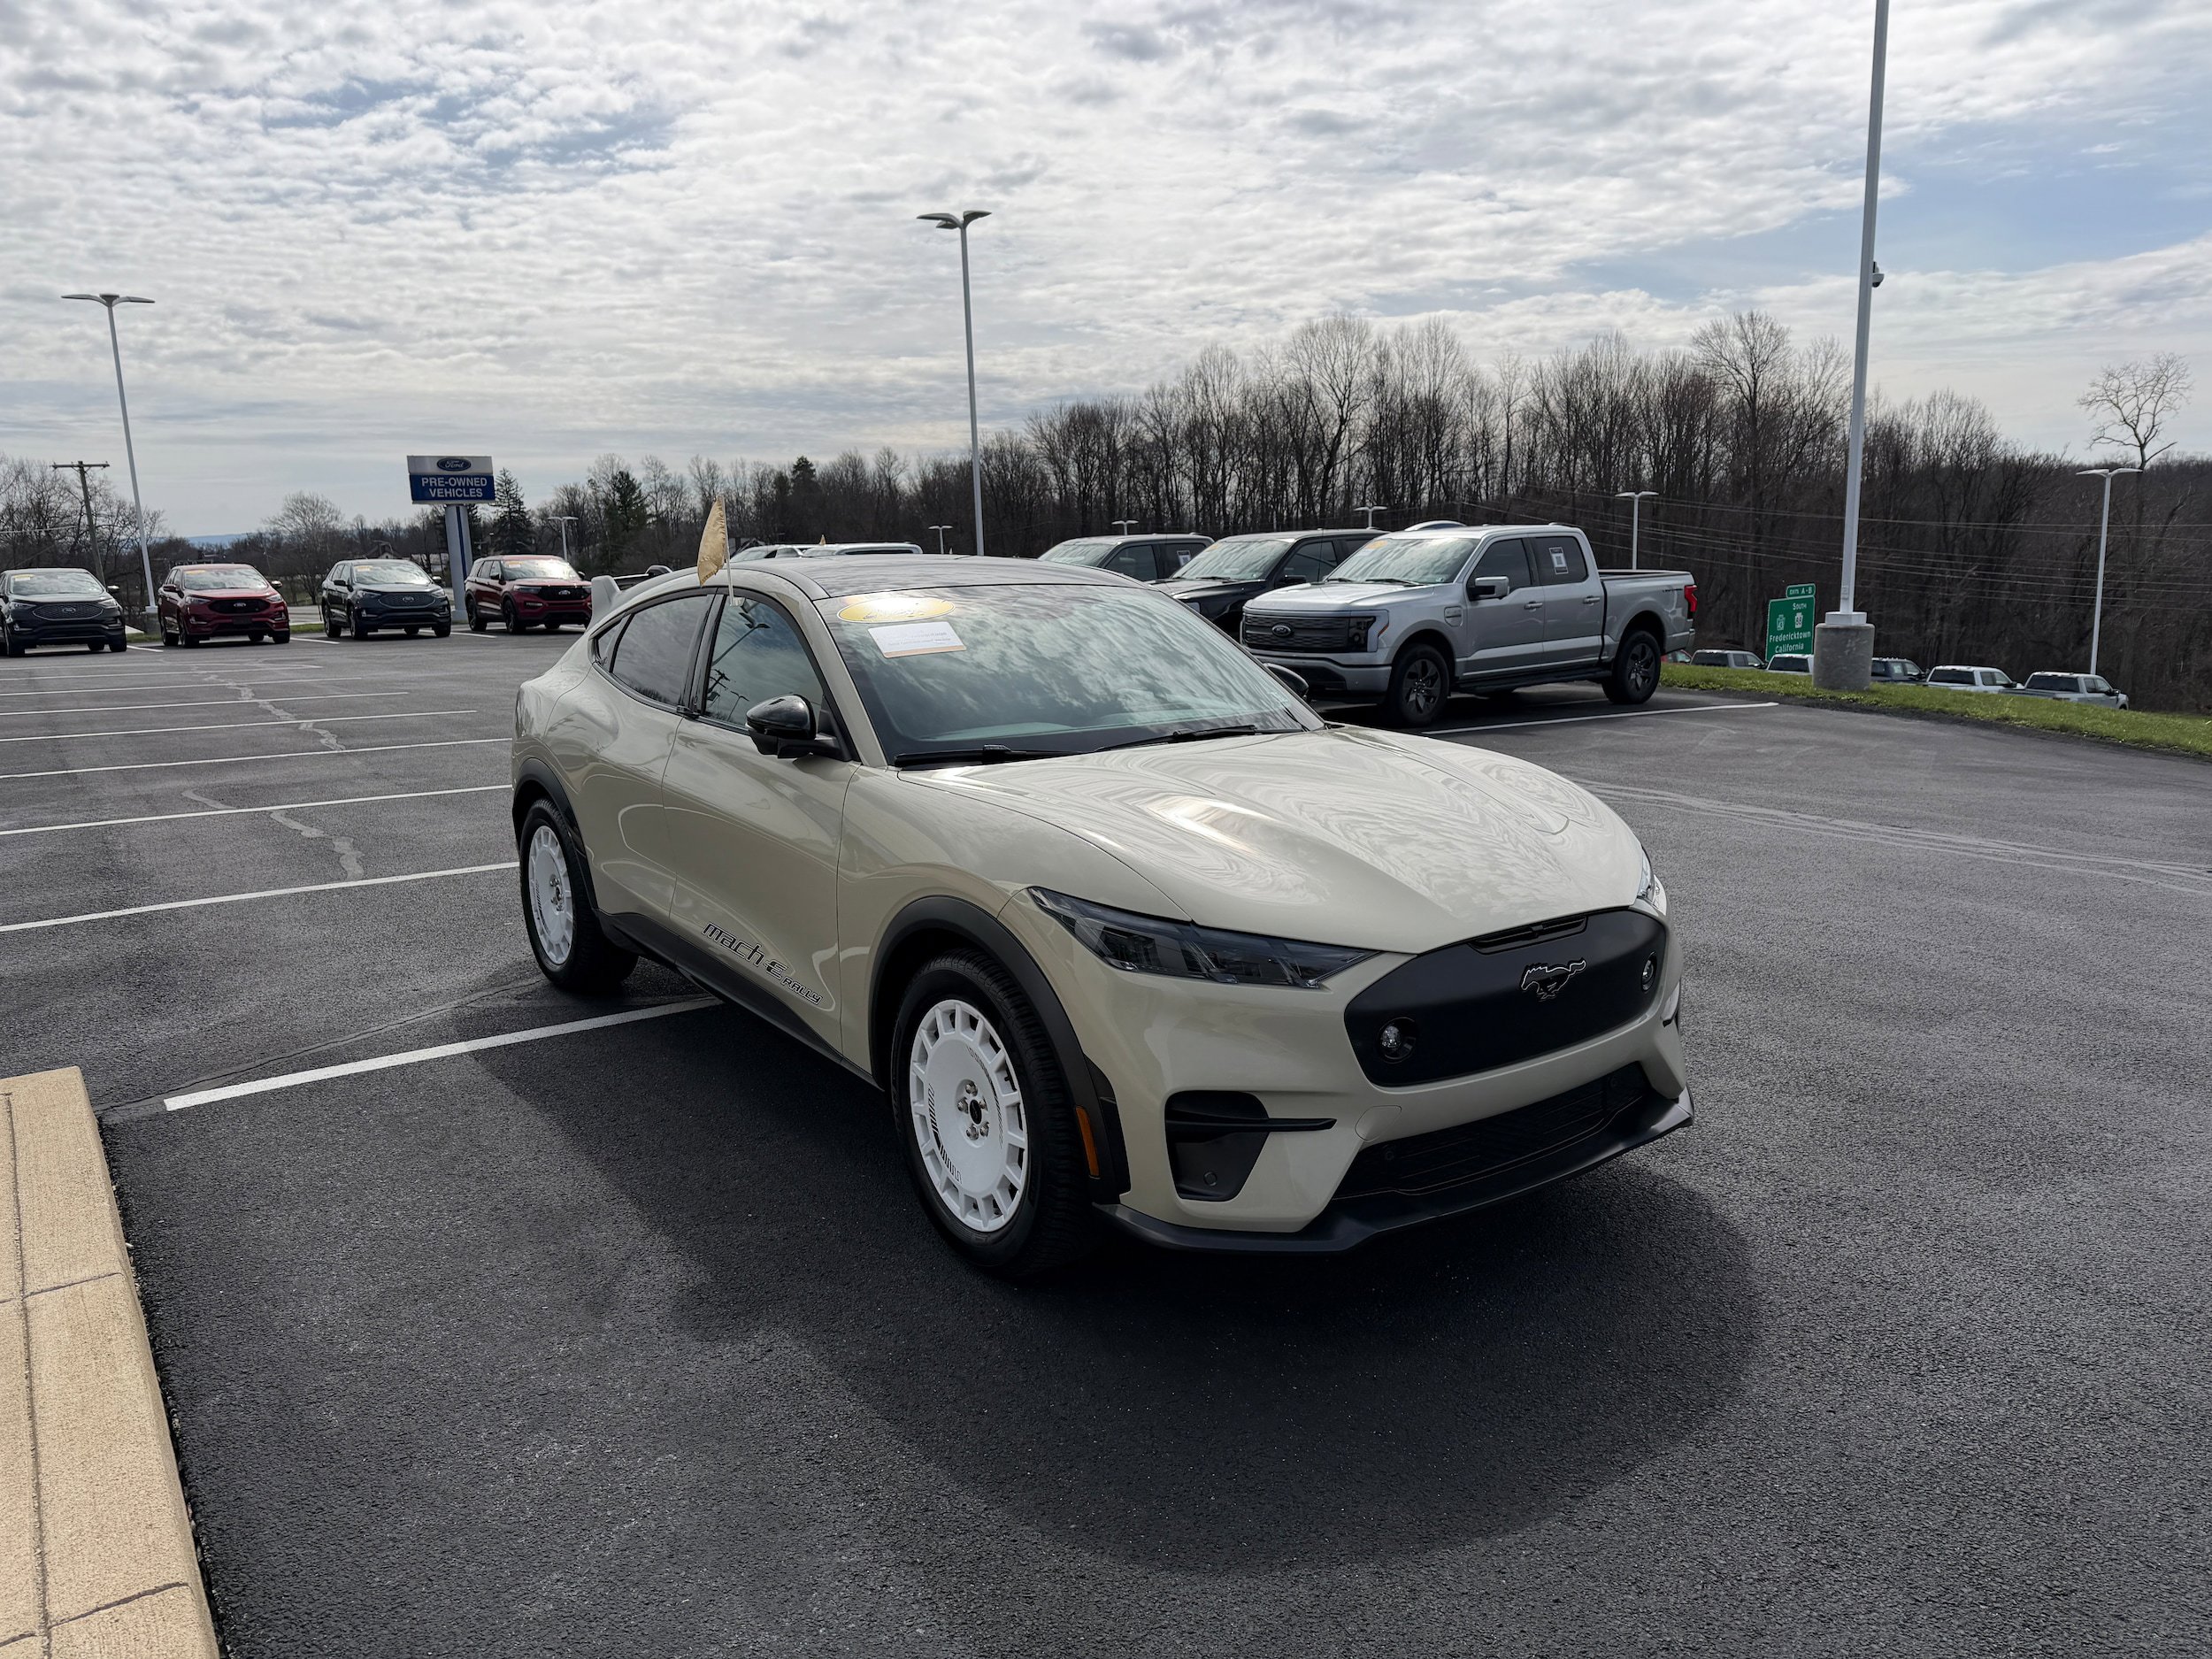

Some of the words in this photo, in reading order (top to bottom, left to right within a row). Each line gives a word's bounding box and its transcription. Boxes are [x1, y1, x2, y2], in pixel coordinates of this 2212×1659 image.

[421, 477, 488, 488] PRE-OWNED
[429, 488, 483, 497] VEHICLES
[1769, 631, 1811, 643] Fredericktown
[1775, 642, 1804, 654] California
